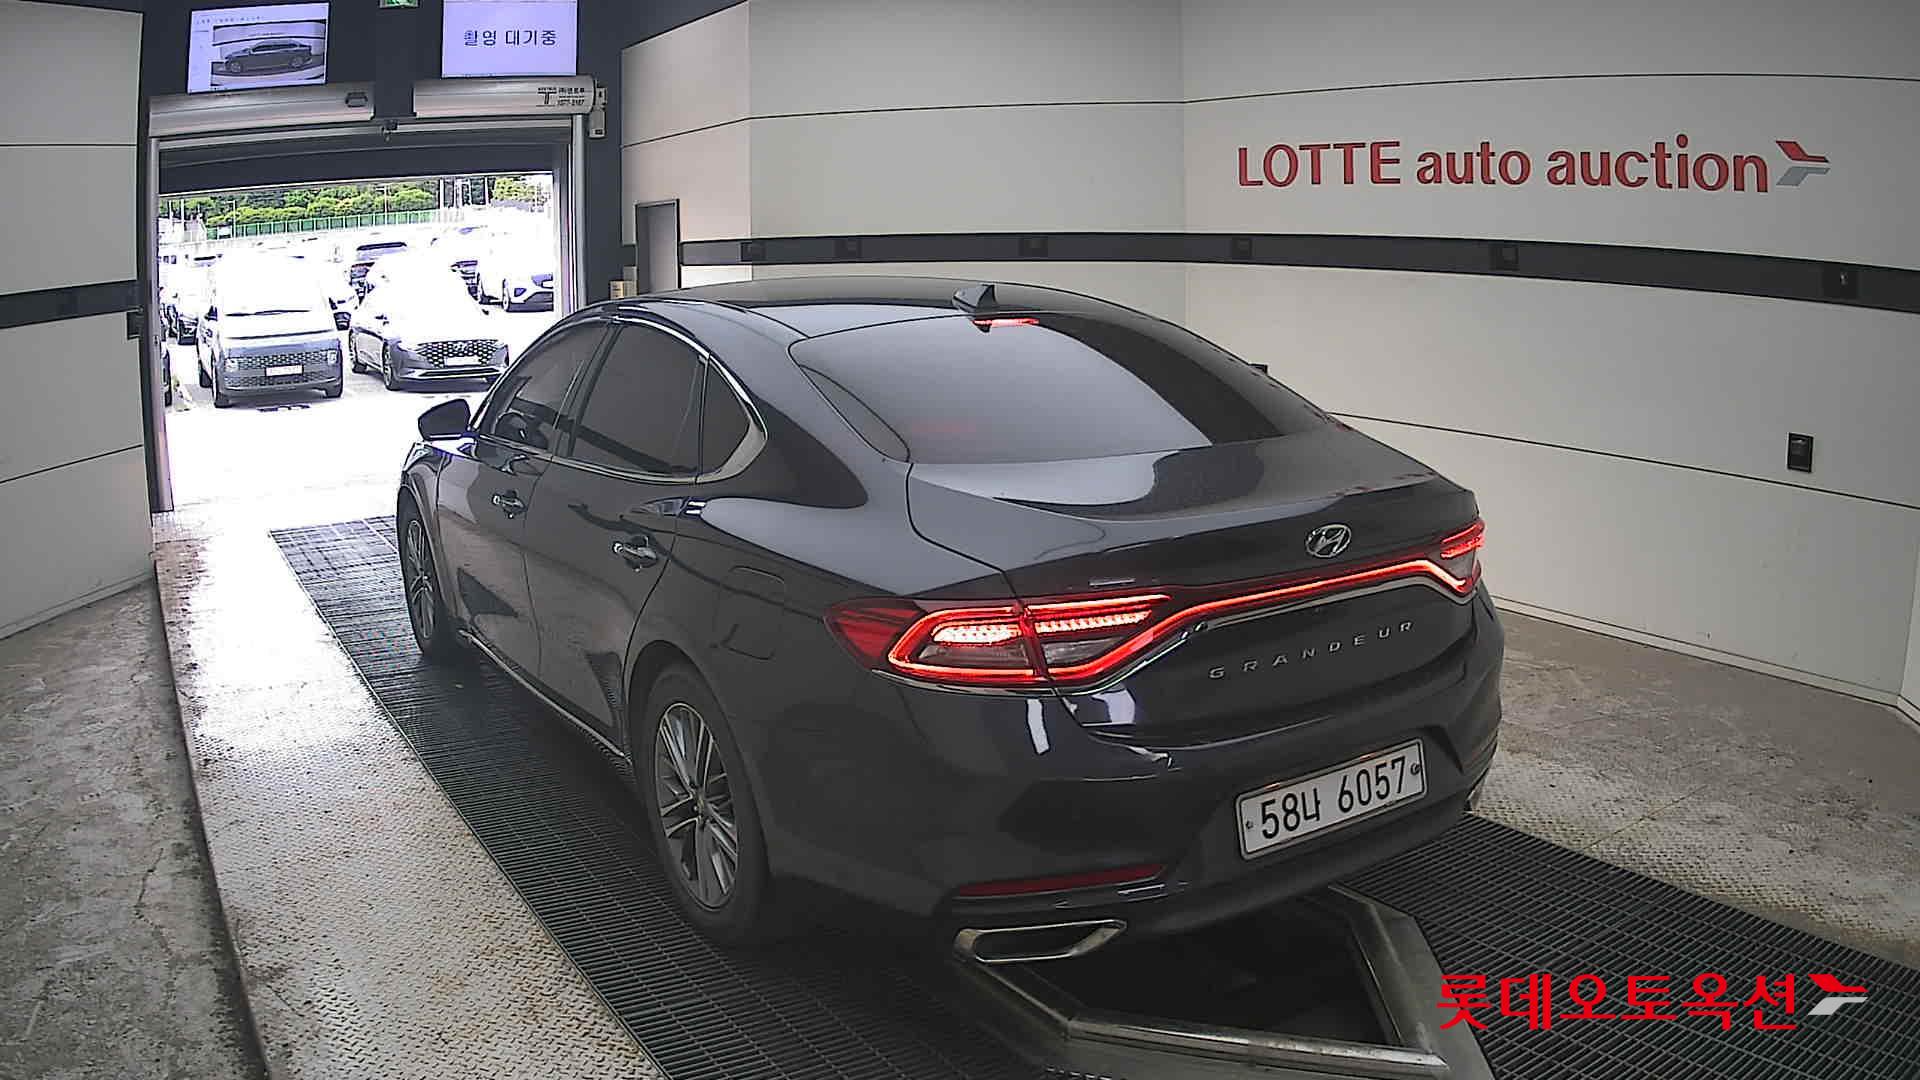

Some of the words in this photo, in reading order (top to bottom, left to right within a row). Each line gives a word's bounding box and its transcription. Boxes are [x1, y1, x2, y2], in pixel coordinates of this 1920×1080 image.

[505, 30, 557, 46] 대기중
[1239, 141, 1400, 187] LOTTE
[1416, 141, 1530, 186] auto
[1547, 135, 1768, 192] auction
[1209, 621, 1413, 679] GRANDEUR
[1261, 787, 1320, 839] 58나
[1338, 755, 1406, 813] 6057
